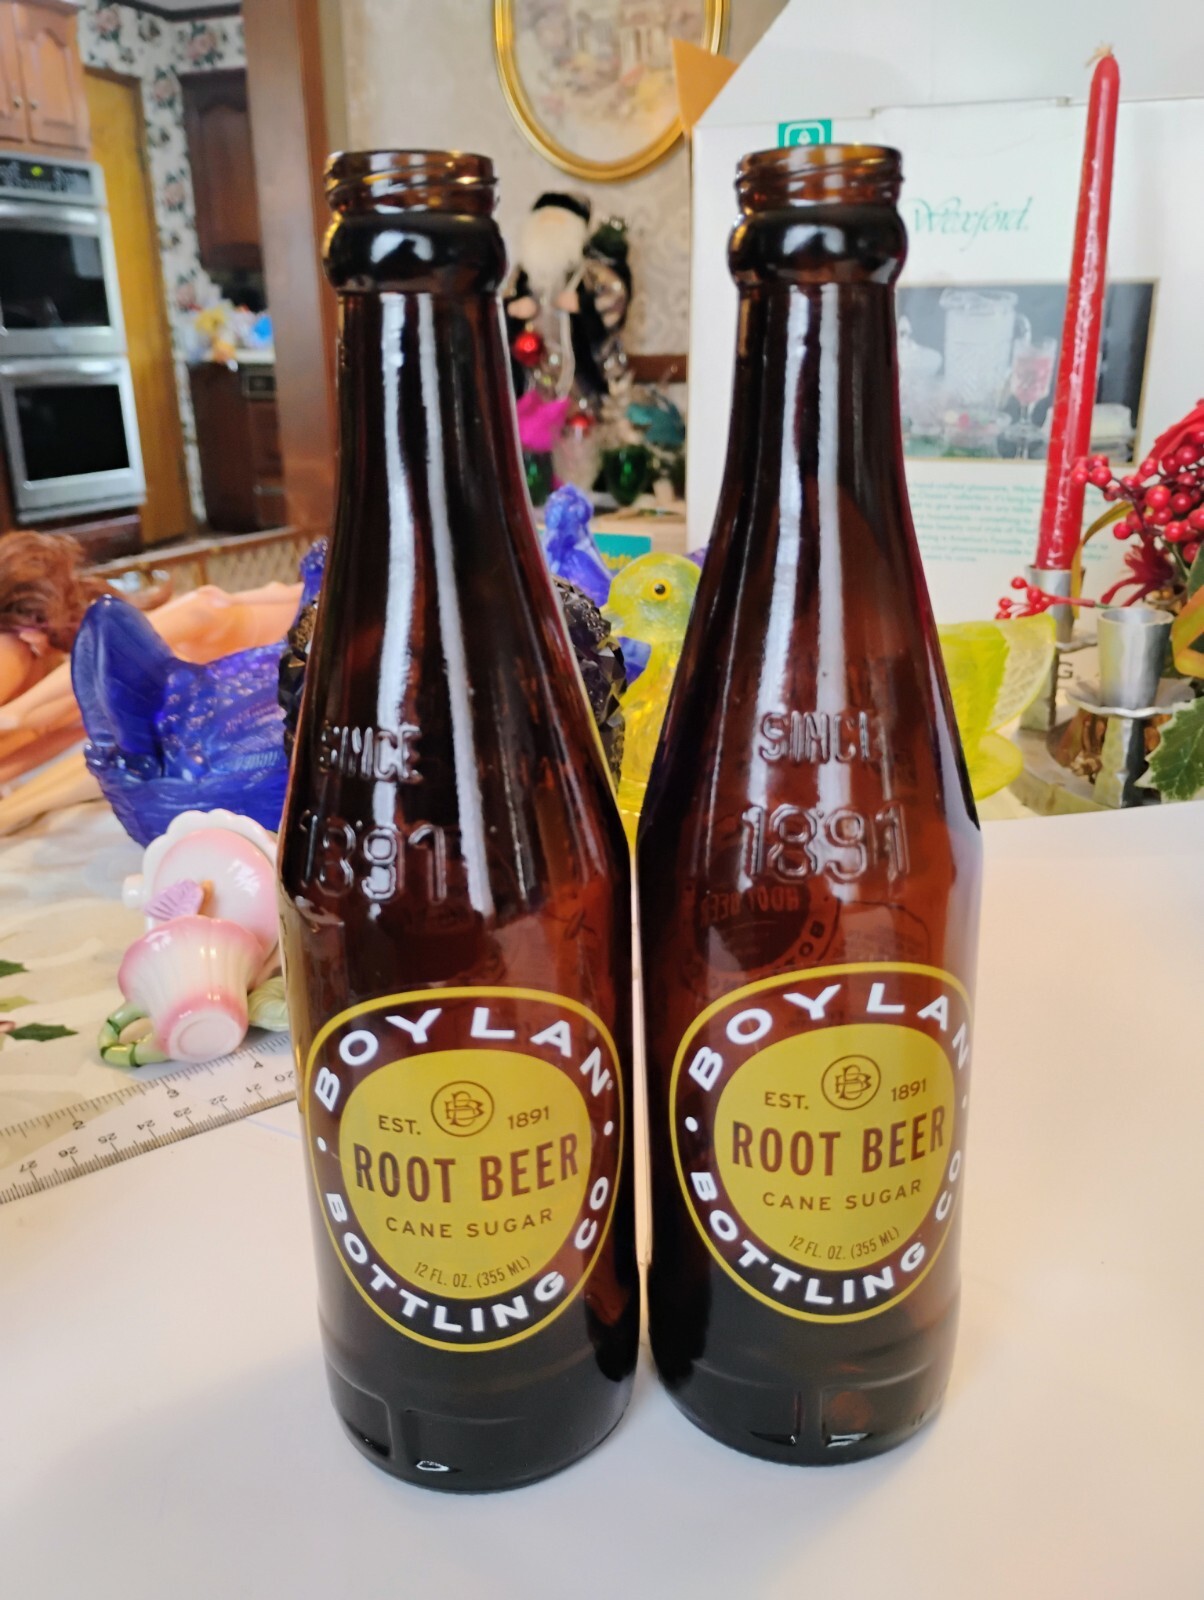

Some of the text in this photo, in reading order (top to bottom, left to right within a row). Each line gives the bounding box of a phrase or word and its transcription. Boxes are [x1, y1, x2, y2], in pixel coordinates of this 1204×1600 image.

[742, 803, 911, 884] 1891
[689, 982, 970, 1091] BOYLAN
[210, 1094, 228, 1106] 22
[764, 1078, 927, 1110] EST. 1891
[136, 1119, 156, 1131] 24
[173, 1107, 192, 1119] 23
[378, 1105, 549, 1135] EST. 1891
[58, 1145, 79, 1158] 26
[98, 1132, 118, 1145] 25
[732, 1105, 945, 1177] ROOT BEER
[19, 1160, 38, 1173] 27
[353, 1132, 578, 1203] ROOT BEER
[762, 1178, 922, 1211] CANE SUGAR
[385, 1208, 553, 1239] CANE SUGAR
[691, 1171, 926, 1305] BOTTLING
[788, 1226, 900, 1260] 12 FL. OZ. (355 ML)
[326, 1192, 565, 1332] BOTTLING
[414, 1255, 531, 1288] 12 FL. OZ. (355 ML)
